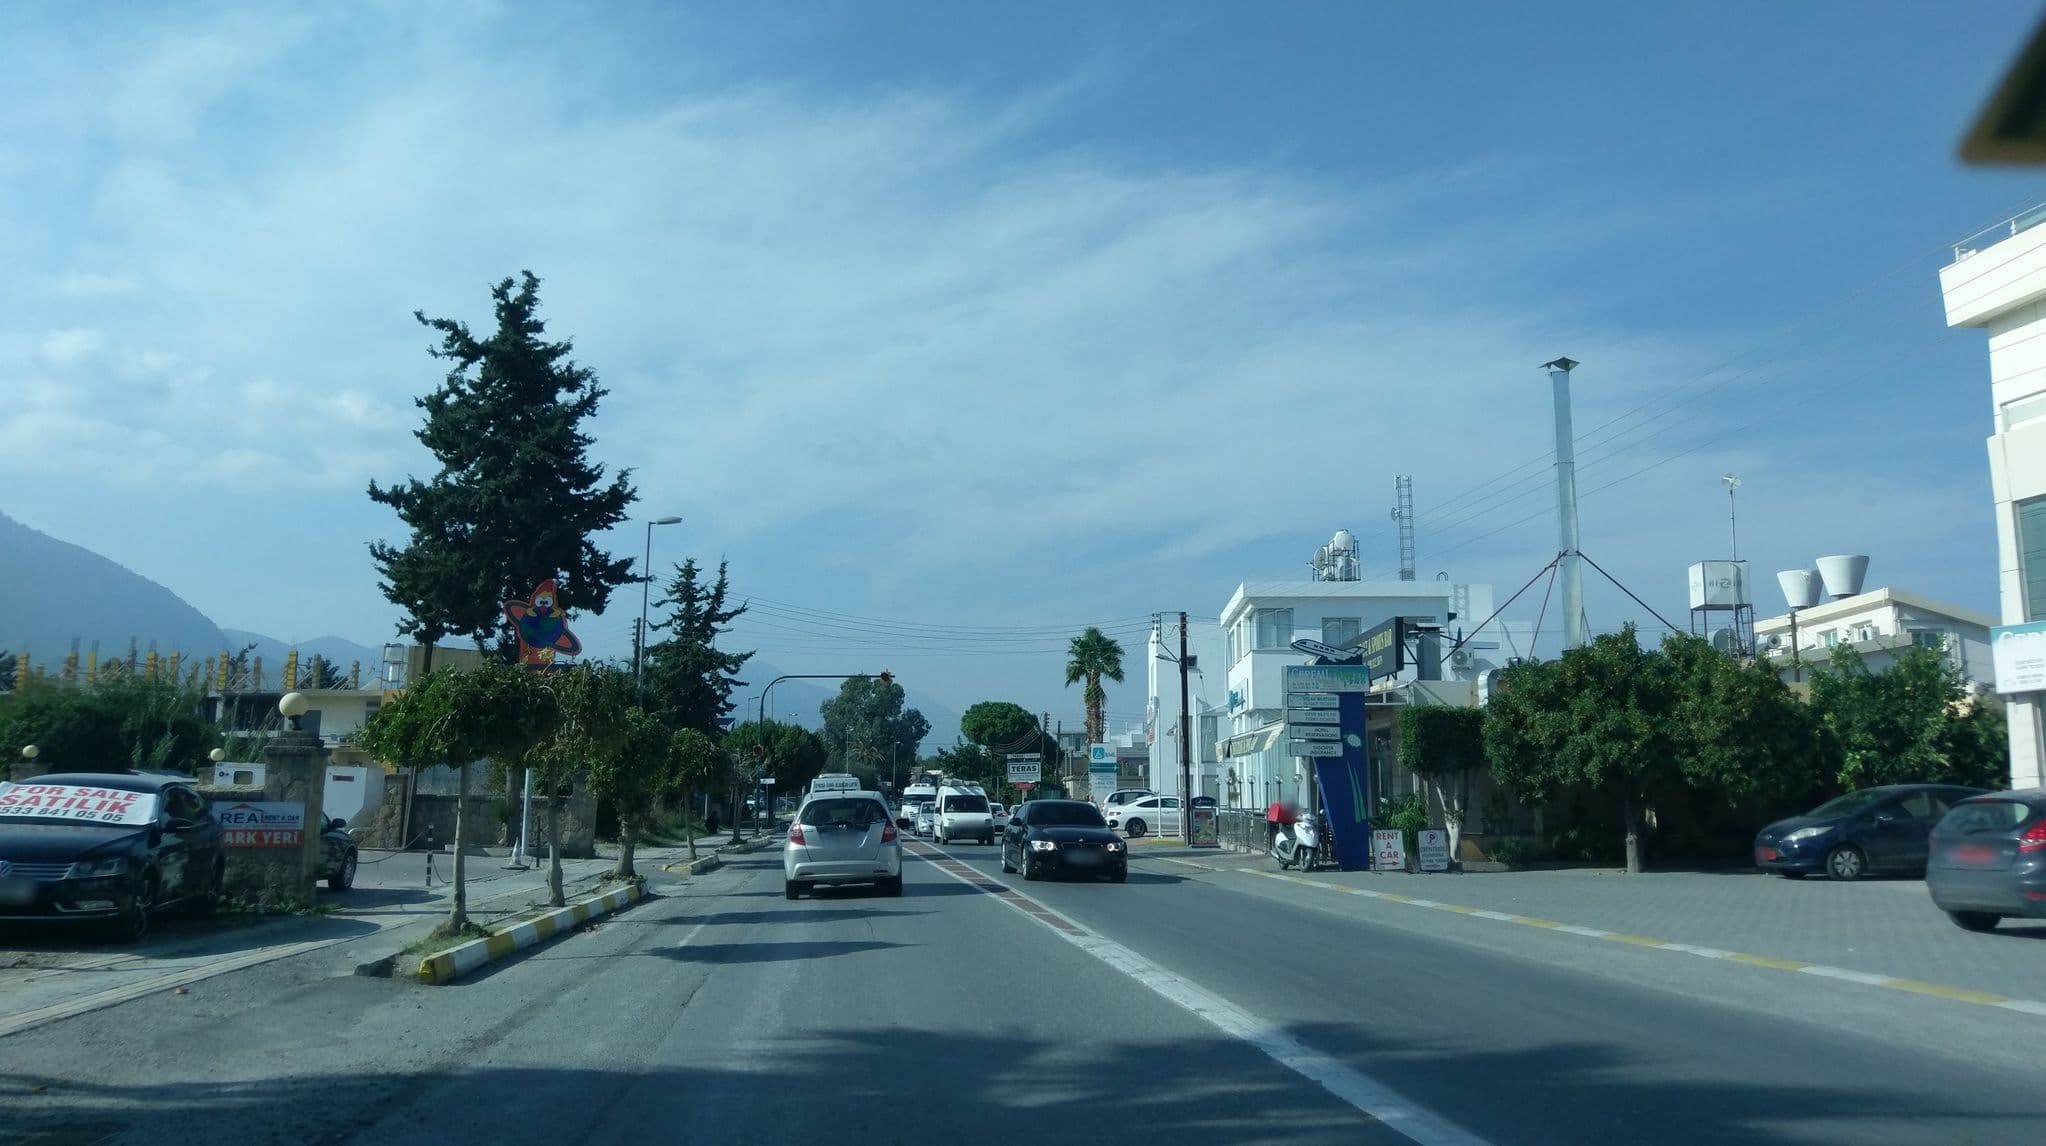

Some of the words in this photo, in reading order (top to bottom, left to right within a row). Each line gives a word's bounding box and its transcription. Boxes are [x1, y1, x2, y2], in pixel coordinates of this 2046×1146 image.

[9, 786, 65, 795] FOR
[74, 788, 143, 802] SALE
[0, 794, 134, 814] SATILIK
[0, 806, 33, 815] 533
[37, 807, 69, 816] 841
[75, 810, 97, 819] 05
[102, 813, 125, 822] 05
[222, 831, 257, 844] ARK
[1376, 832, 1399, 841] RENT
[1380, 851, 1398, 859] CAR
